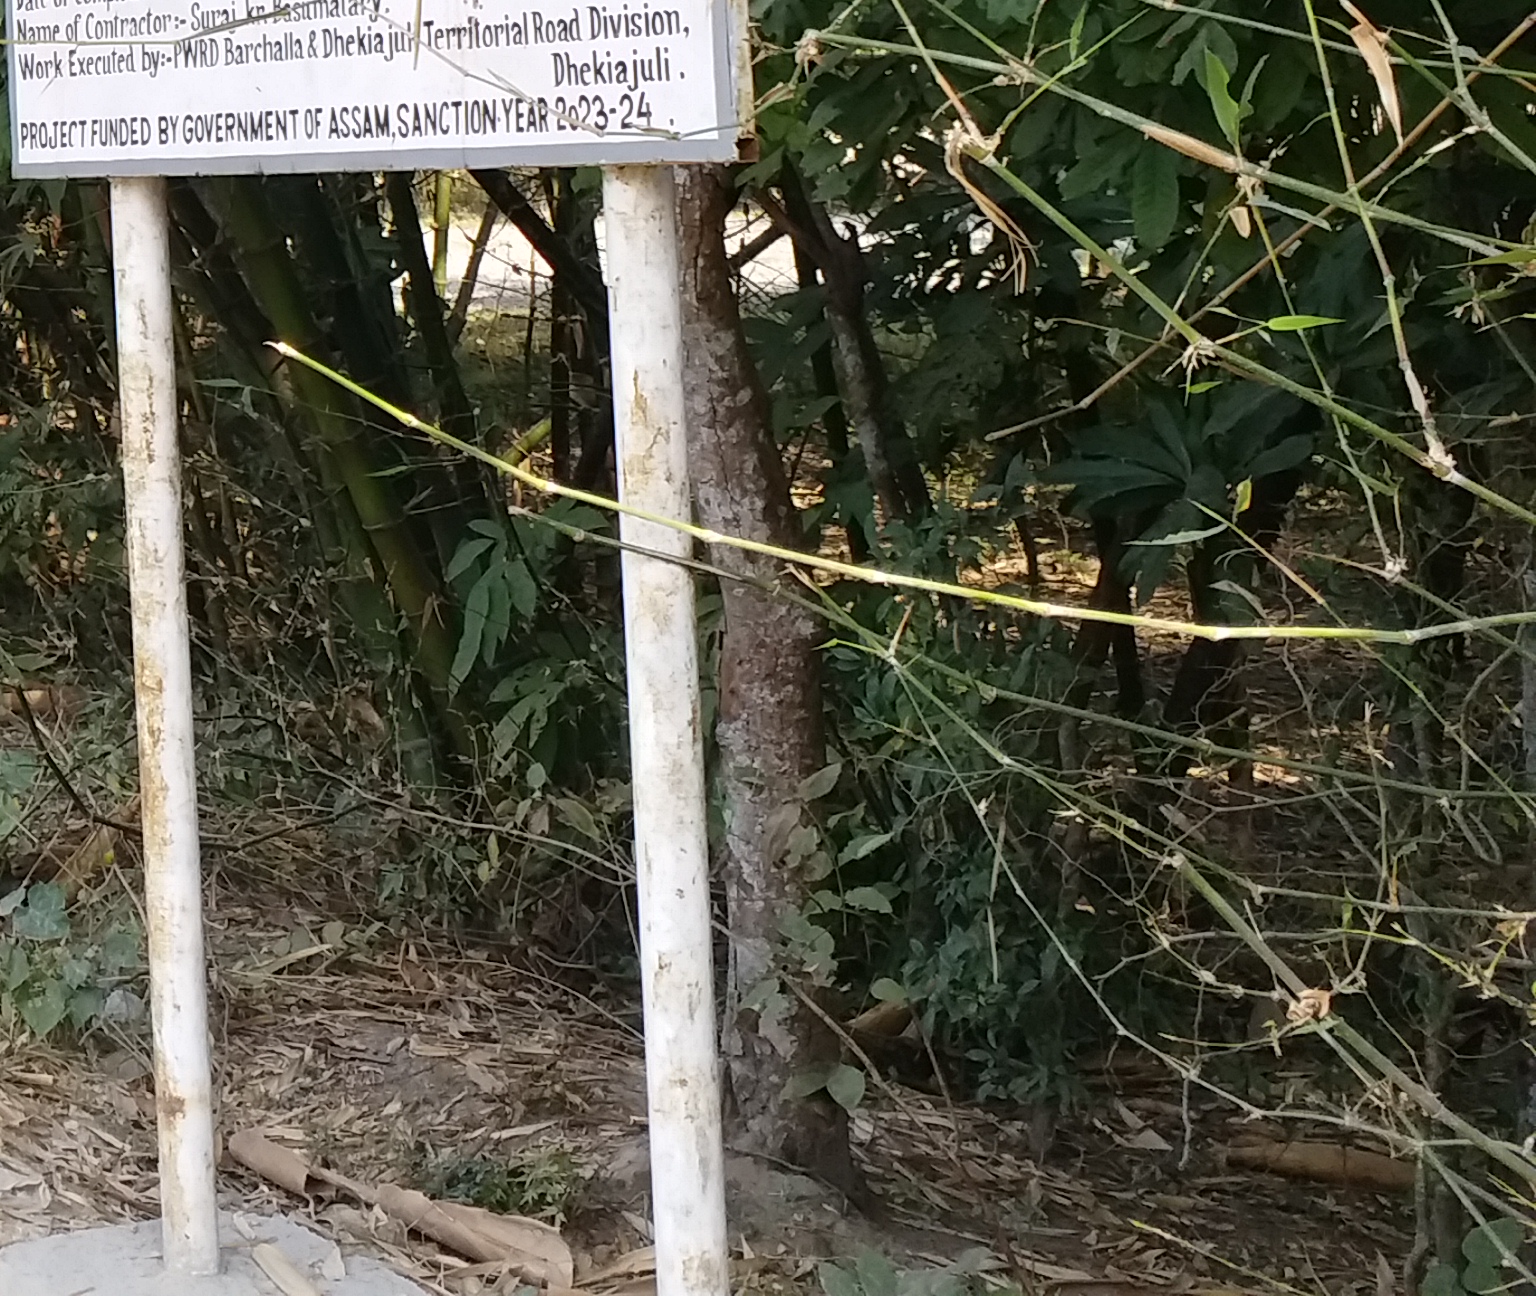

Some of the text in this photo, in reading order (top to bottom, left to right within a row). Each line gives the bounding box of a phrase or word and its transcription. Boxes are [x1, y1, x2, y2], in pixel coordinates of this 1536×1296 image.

[17, 18, 60, 42] Name
[65, 17, 80, 42] of
[18, 51, 63, 81] Work
[68, 46, 135, 77] Executed
[224, 32, 305, 66] Barchalla
[307, 30, 319, 59] &
[423, 12, 529, 50] Territorial
[532, 9, 579, 43] Road
[587, 3, 690, 41] Division,
[20, 119, 87, 149] PROJECT
[91, 115, 151, 147] FUNDED
[158, 115, 178, 145] BY
[182, 109, 298, 144] GOVERNMENT
[304, 108, 323, 139] OF
